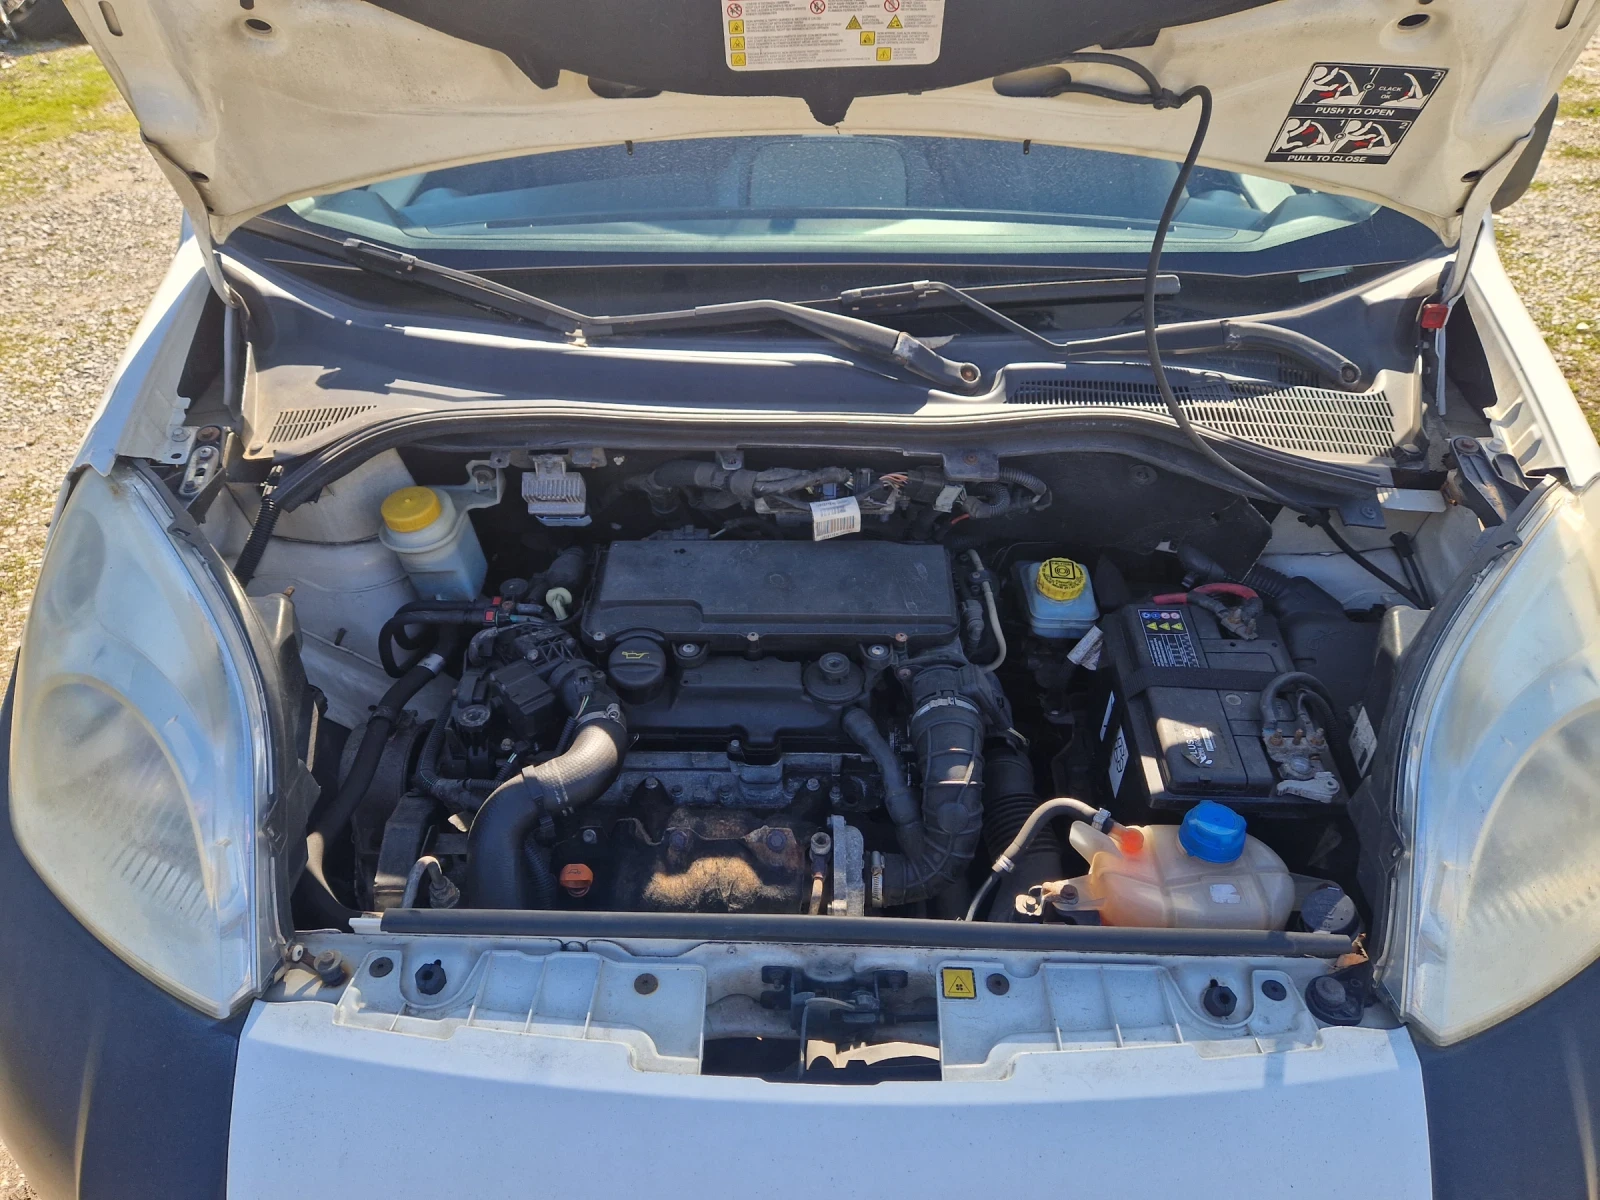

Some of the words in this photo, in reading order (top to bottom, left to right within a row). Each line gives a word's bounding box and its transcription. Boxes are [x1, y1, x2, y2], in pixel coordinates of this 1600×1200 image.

[1369, 67, 1376, 76] 1
[1431, 71, 1441, 80] 2
[1315, 106, 1346, 115] PUSH
[1348, 107, 1363, 116] TO
[1364, 108, 1395, 117] OPEN
[1339, 119, 1346, 127] 1
[1398, 121, 1409, 130] 2
[1287, 154, 1313, 163] PULL
[1316, 155, 1330, 163] TO
[1331, 155, 1368, 164] CLOSE
